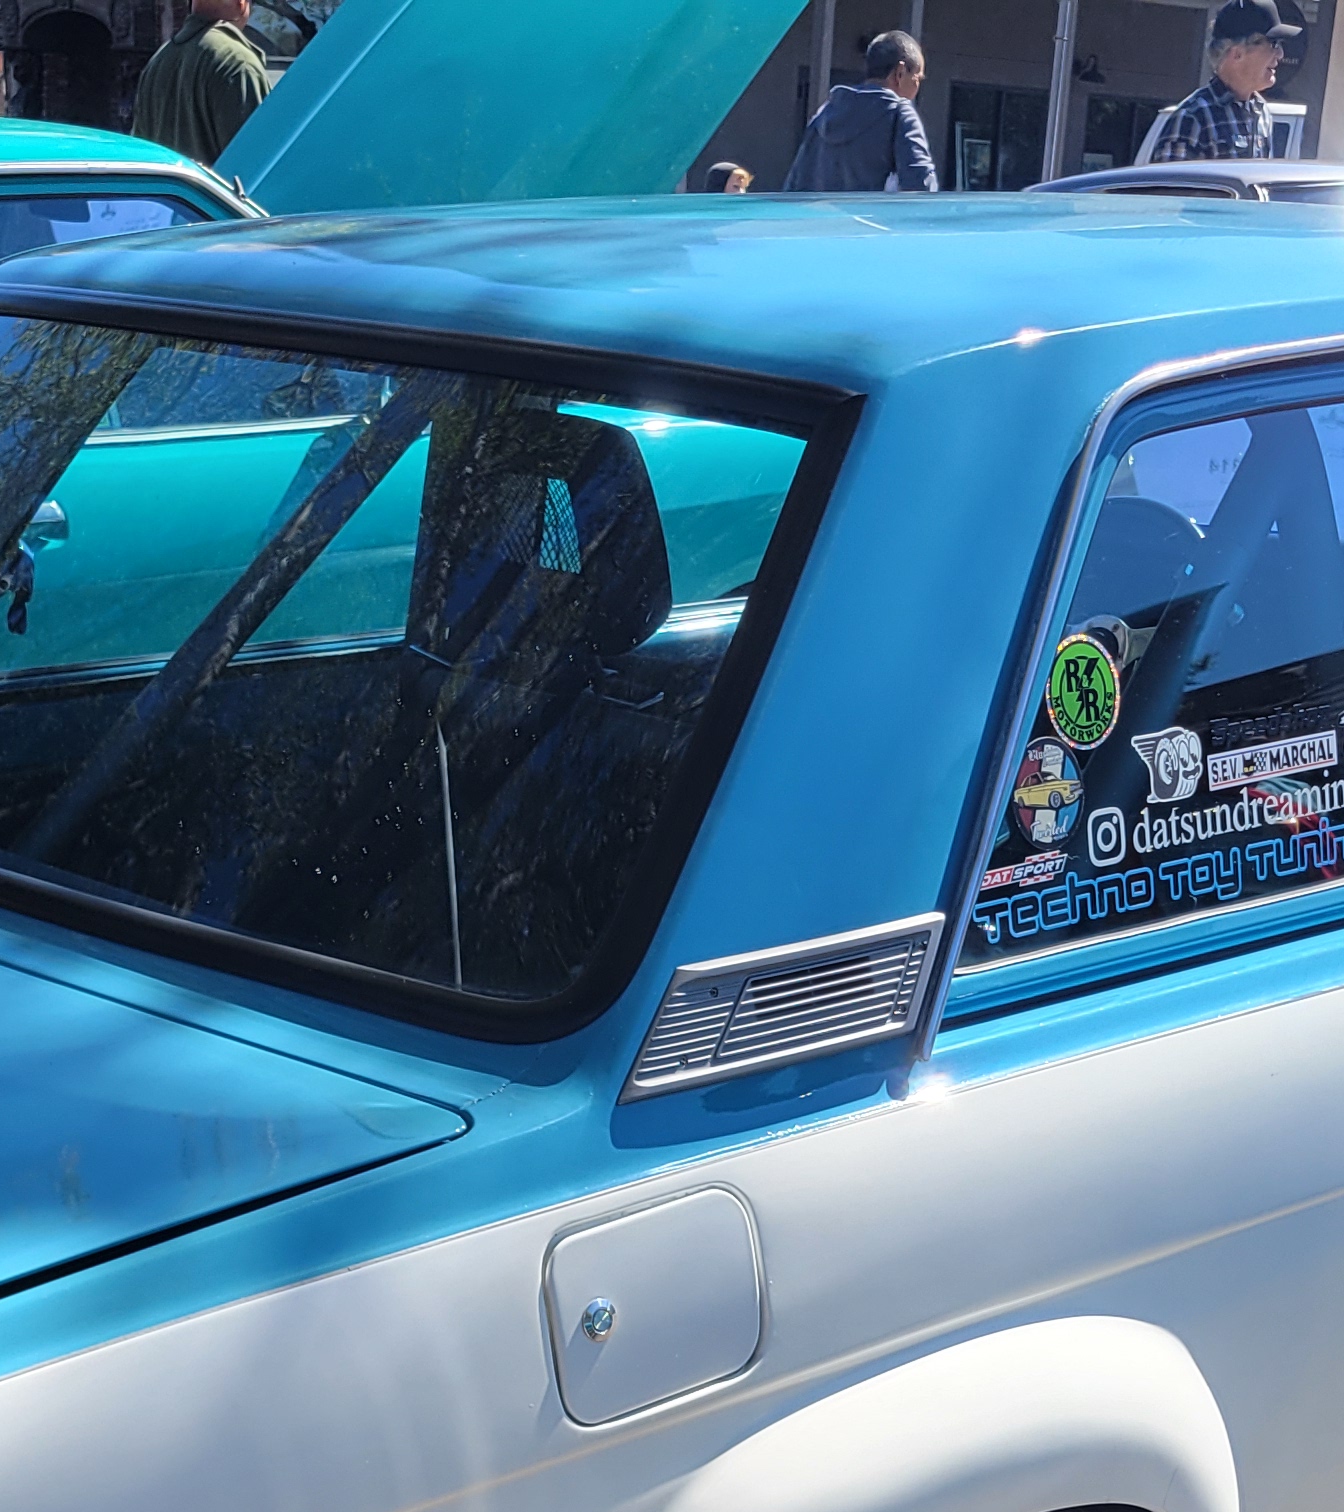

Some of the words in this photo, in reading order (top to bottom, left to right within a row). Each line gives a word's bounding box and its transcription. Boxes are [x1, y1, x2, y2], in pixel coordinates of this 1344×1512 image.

[1051, 691, 1114, 741] MOTORWORKS
[1210, 757, 1242, 784] S.E.V.
[1268, 739, 1334, 772] MARCHAL
[1159, 846, 1241, 901] Toy
